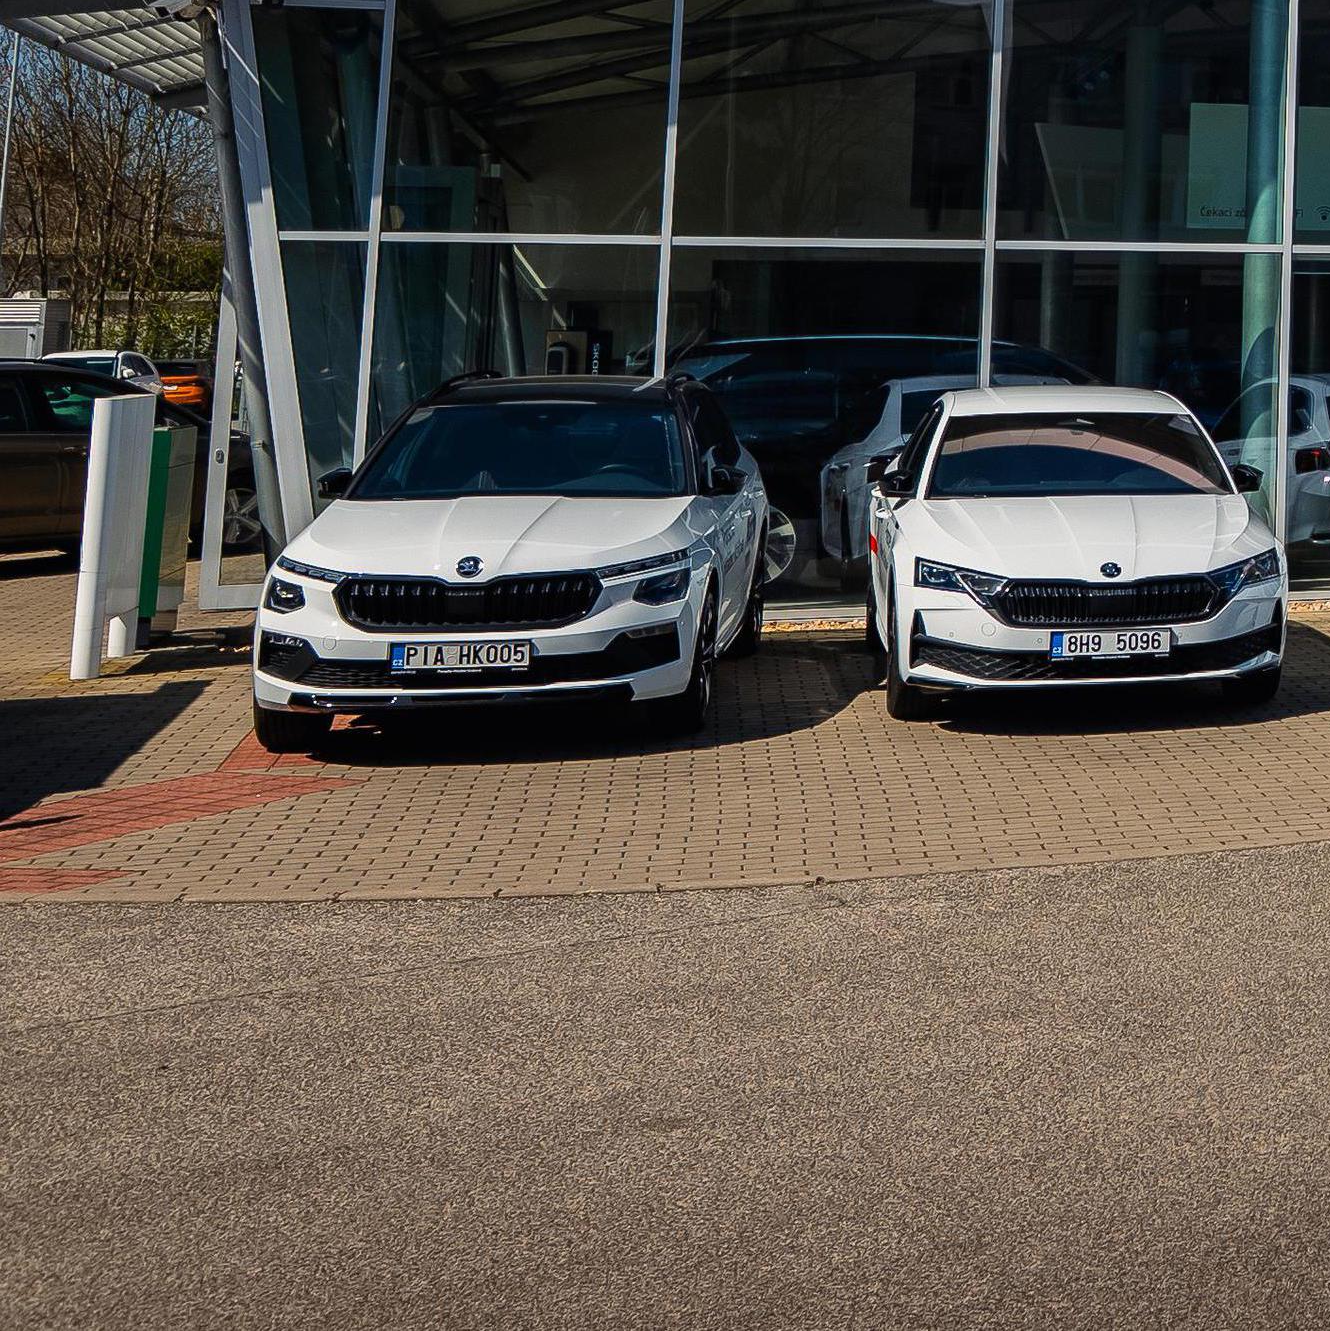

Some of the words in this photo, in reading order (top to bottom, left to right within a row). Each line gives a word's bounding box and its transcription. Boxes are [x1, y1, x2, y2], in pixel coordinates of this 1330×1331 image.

[1067, 634, 1102, 654] 8H9
[1116, 631, 1161, 652] 5096
[392, 658, 403, 666] CZ
[459, 643, 526, 665] HK005
